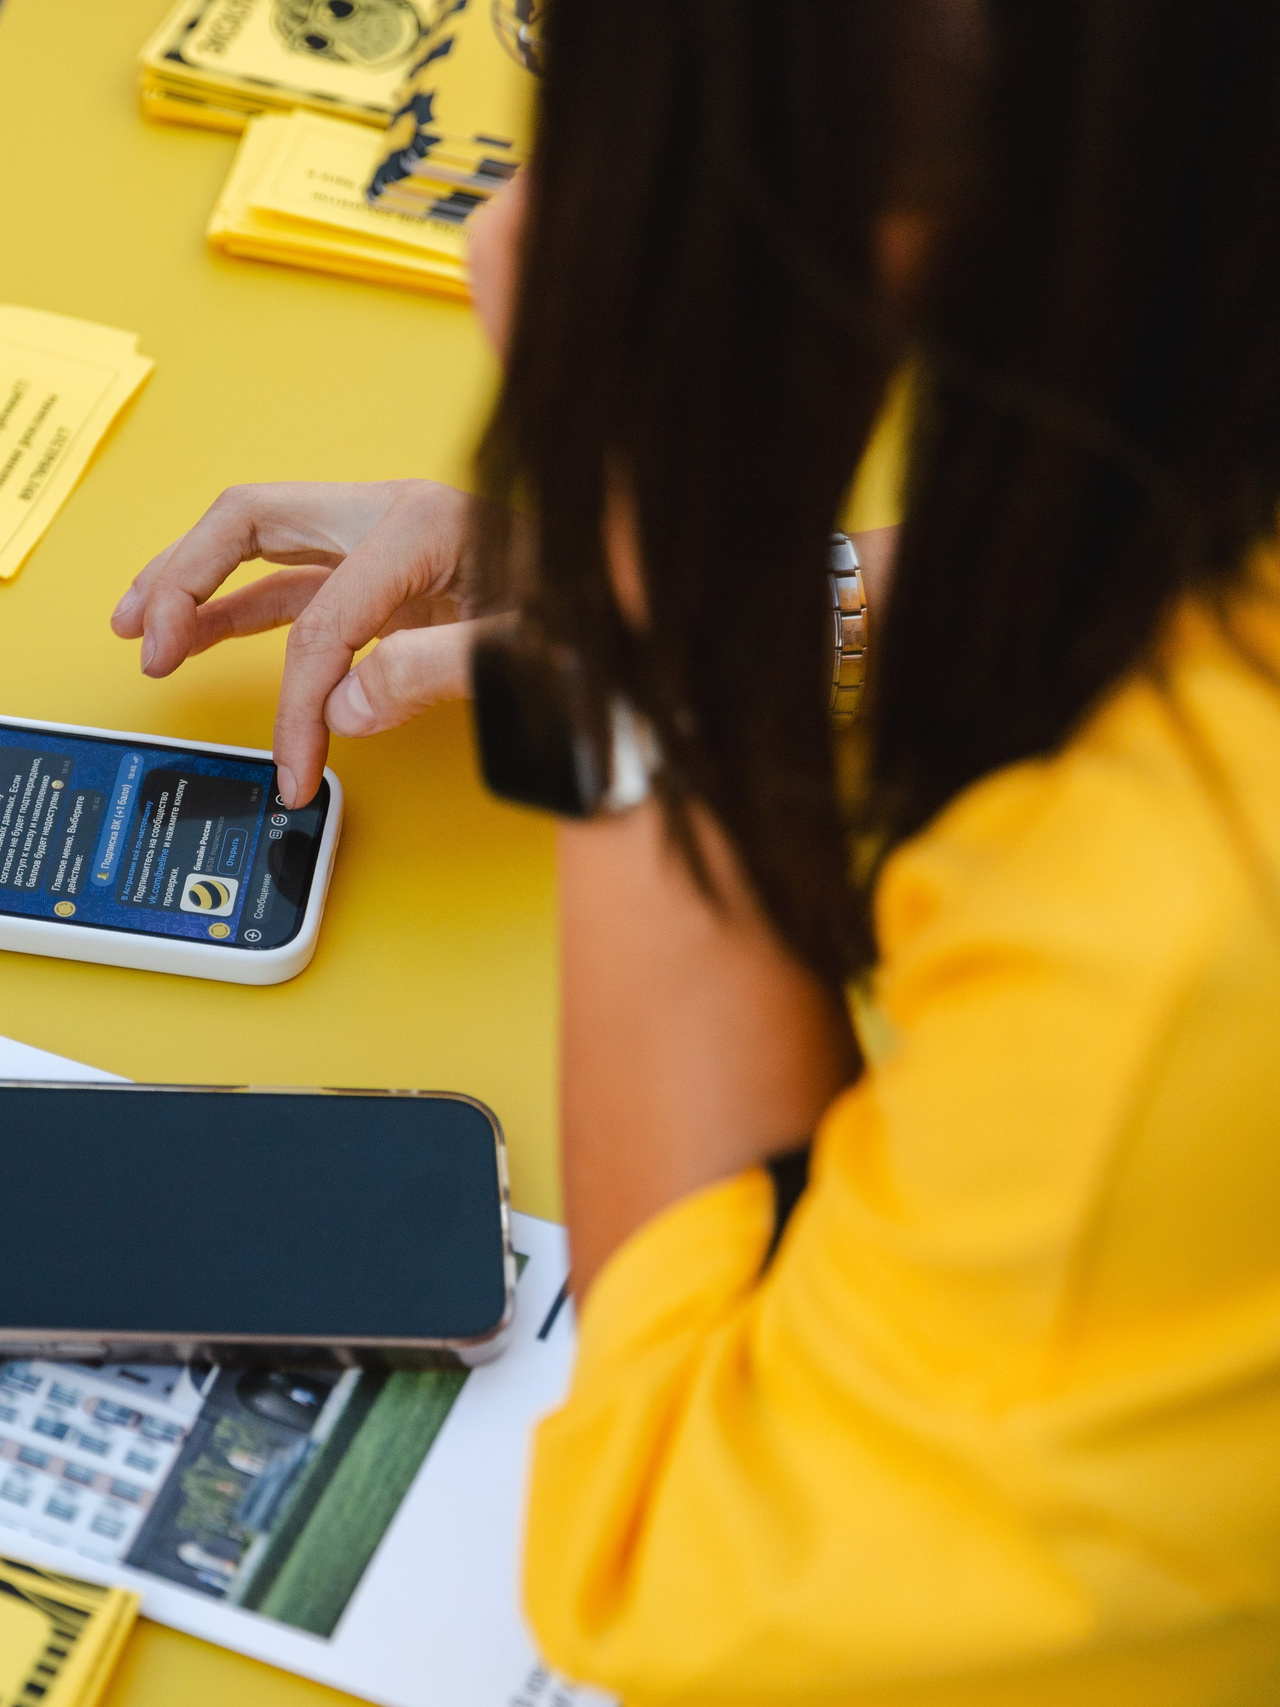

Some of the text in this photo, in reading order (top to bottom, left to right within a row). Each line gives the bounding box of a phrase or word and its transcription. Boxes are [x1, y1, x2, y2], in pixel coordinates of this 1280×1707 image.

[8, 774, 22, 793] Если
[17, 756, 43, 813] подтверждено,
[0, 793, 18, 825] данных.
[10, 813, 26, 837] будет
[66, 795, 87, 833] Выберите
[99, 783, 133, 869] Подписка ВК (+1 балл)
[133, 800, 155, 849] по-настоящему
[8, 837, 19, 847] не
[12, 857, 29, 886] доступ
[22, 828, 37, 851] квизу
[30, 774, 51, 821] накоплению
[25, 790, 62, 887] баллов будет недоступен
[60, 834, 76, 859] меню.
[131, 791, 171, 903] Подпишитесь на сообщество
[145, 847, 172, 905] vk.com/beeline
[163, 806, 181, 841] нажмите
[172, 778, 190, 806] кнопку
[191, 819, 214, 871] билайн Россия
[130, 848, 140, 860] всё
[224, 836, 242, 867] Открыть
[50, 859, 68, 891] Главное
[65, 853, 85, 893] действие:
[121, 860, 139, 895] Астрахани
[161, 866, 182, 907] проверки.
[251, 873, 275, 919] Сообщение
